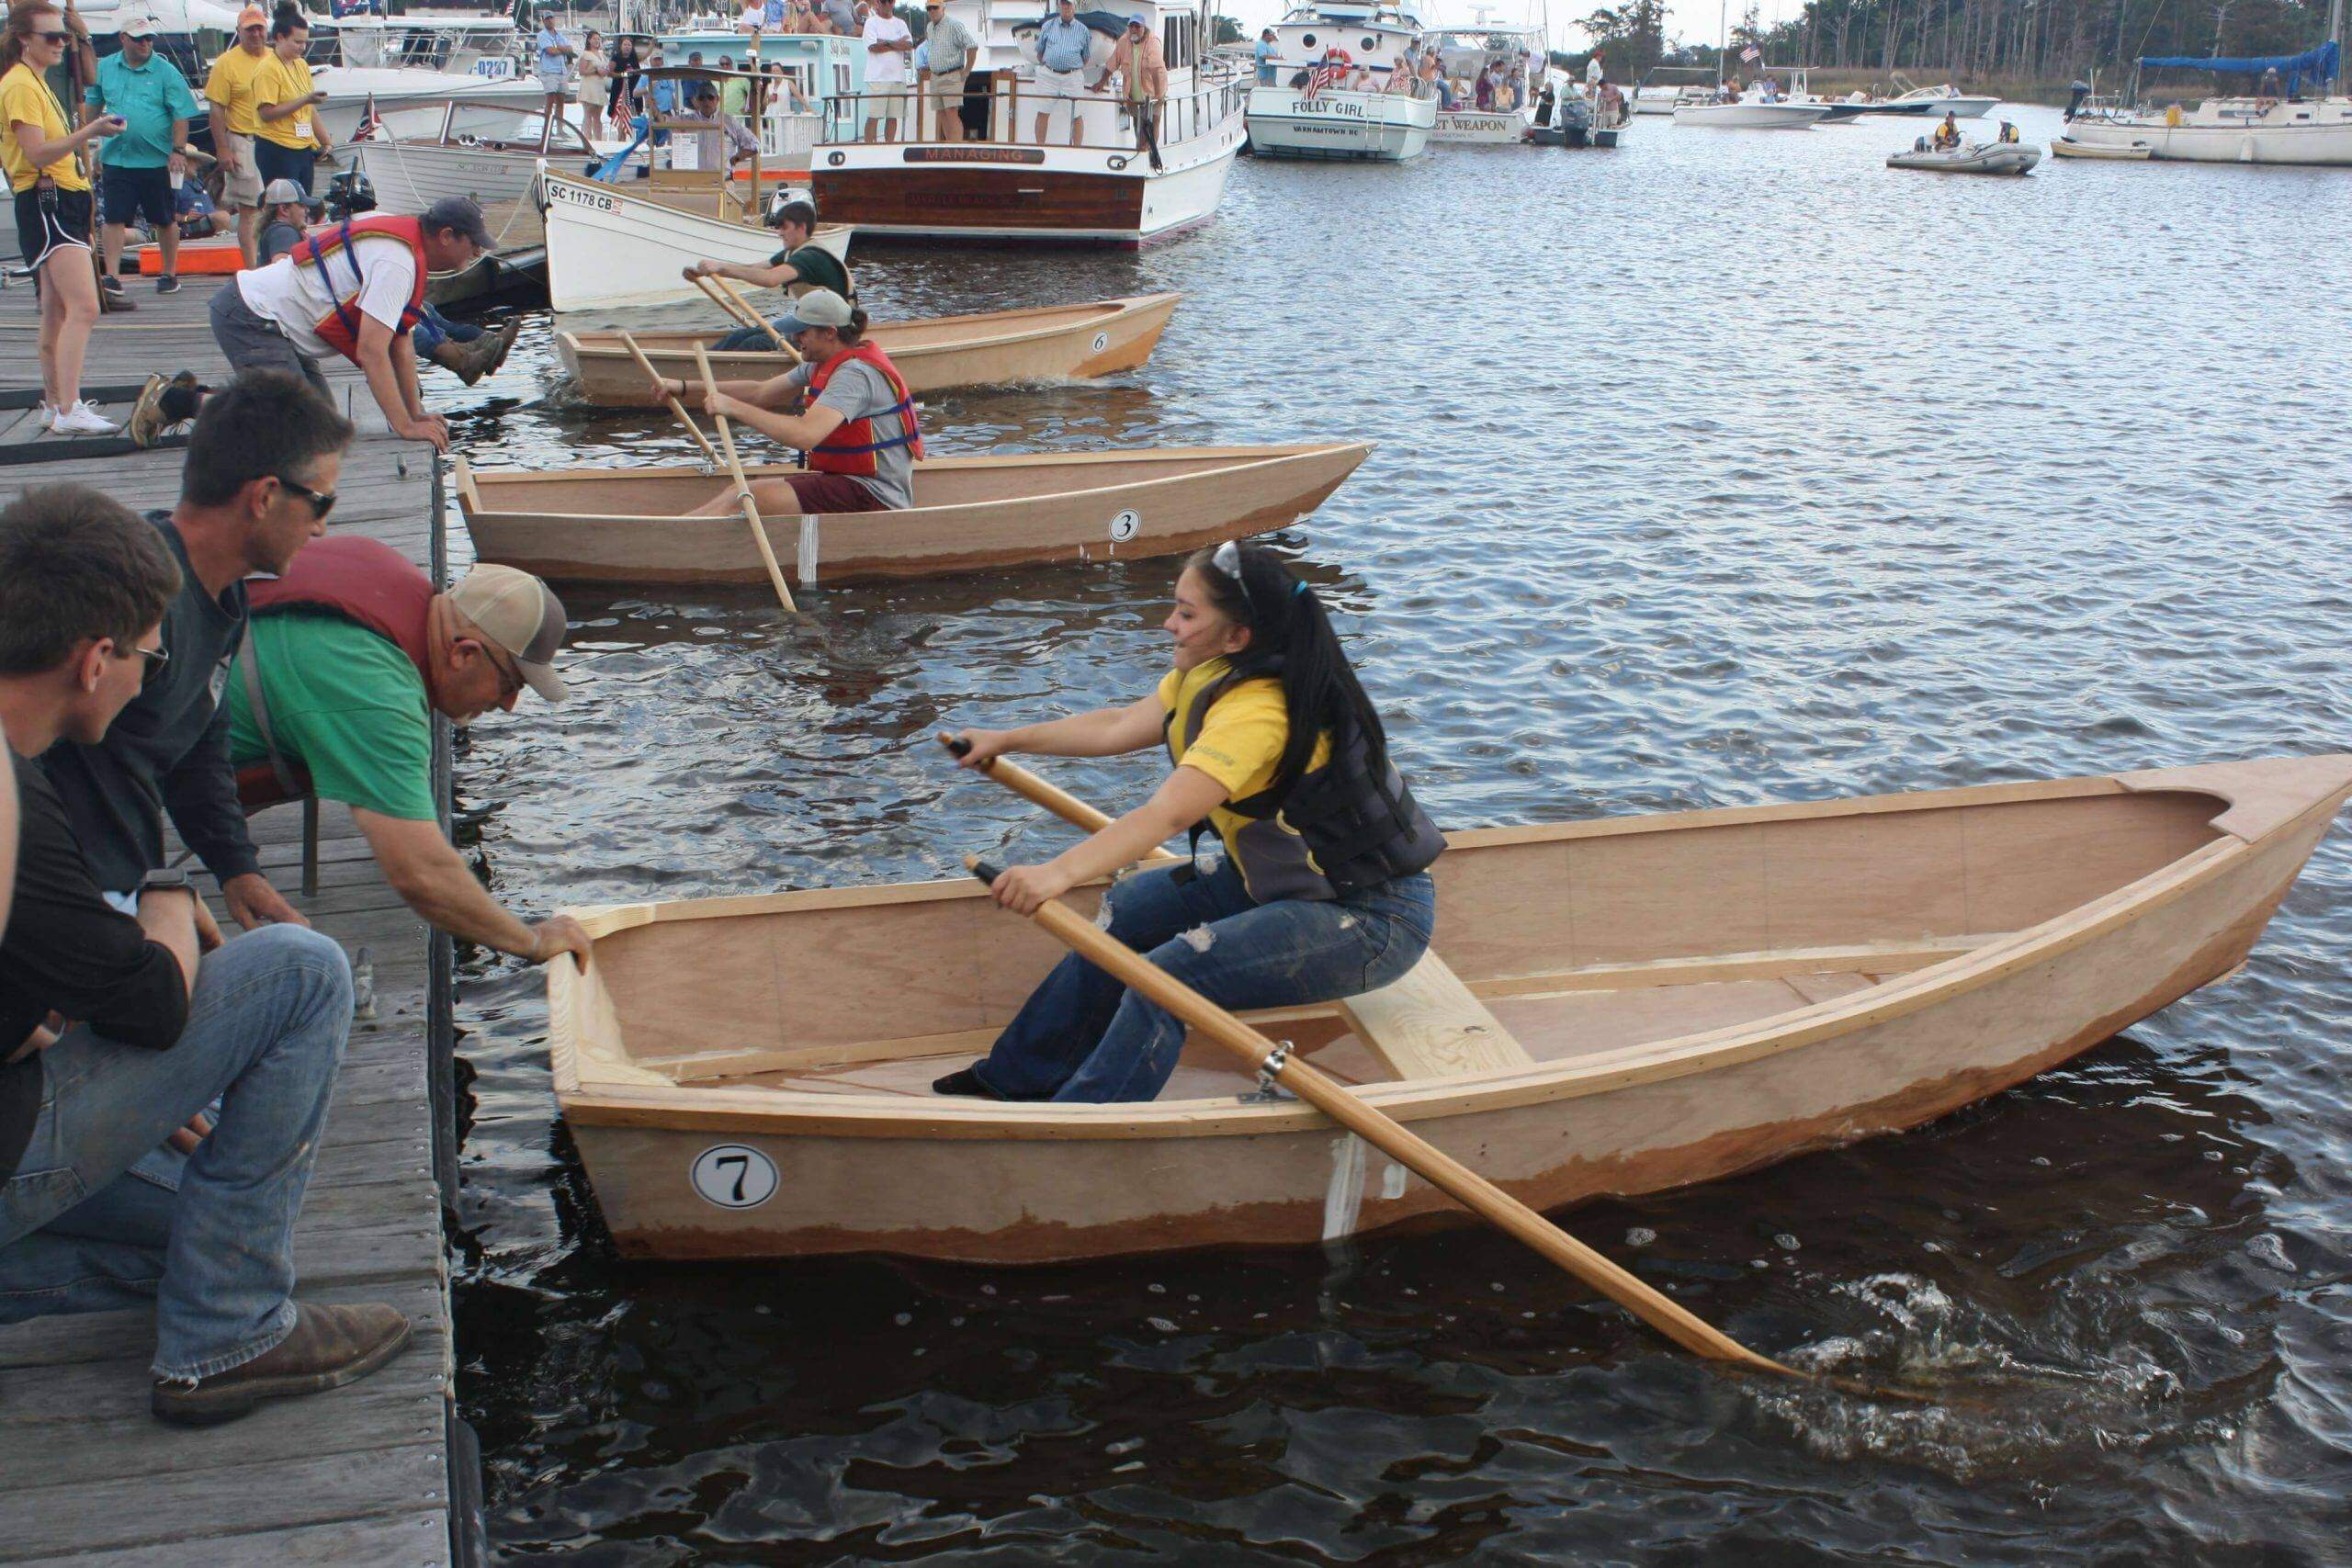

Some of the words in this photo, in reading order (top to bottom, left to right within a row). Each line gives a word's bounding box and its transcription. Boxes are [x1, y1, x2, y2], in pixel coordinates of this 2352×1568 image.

[1292, 100, 1329, 114] FOLLY
[1335, 102, 1364, 118] GIRL
[1453, 119, 1507, 131] WEAPON
[925, 148, 1023, 162] MANAGING
[550, 186, 567, 199] SC
[569, 190, 595, 207] 1178
[597, 197, 613, 210] CB
[1094, 334, 1106, 350] 6
[1116, 514, 1132, 537] 3
[716, 1155, 749, 1201] 7
